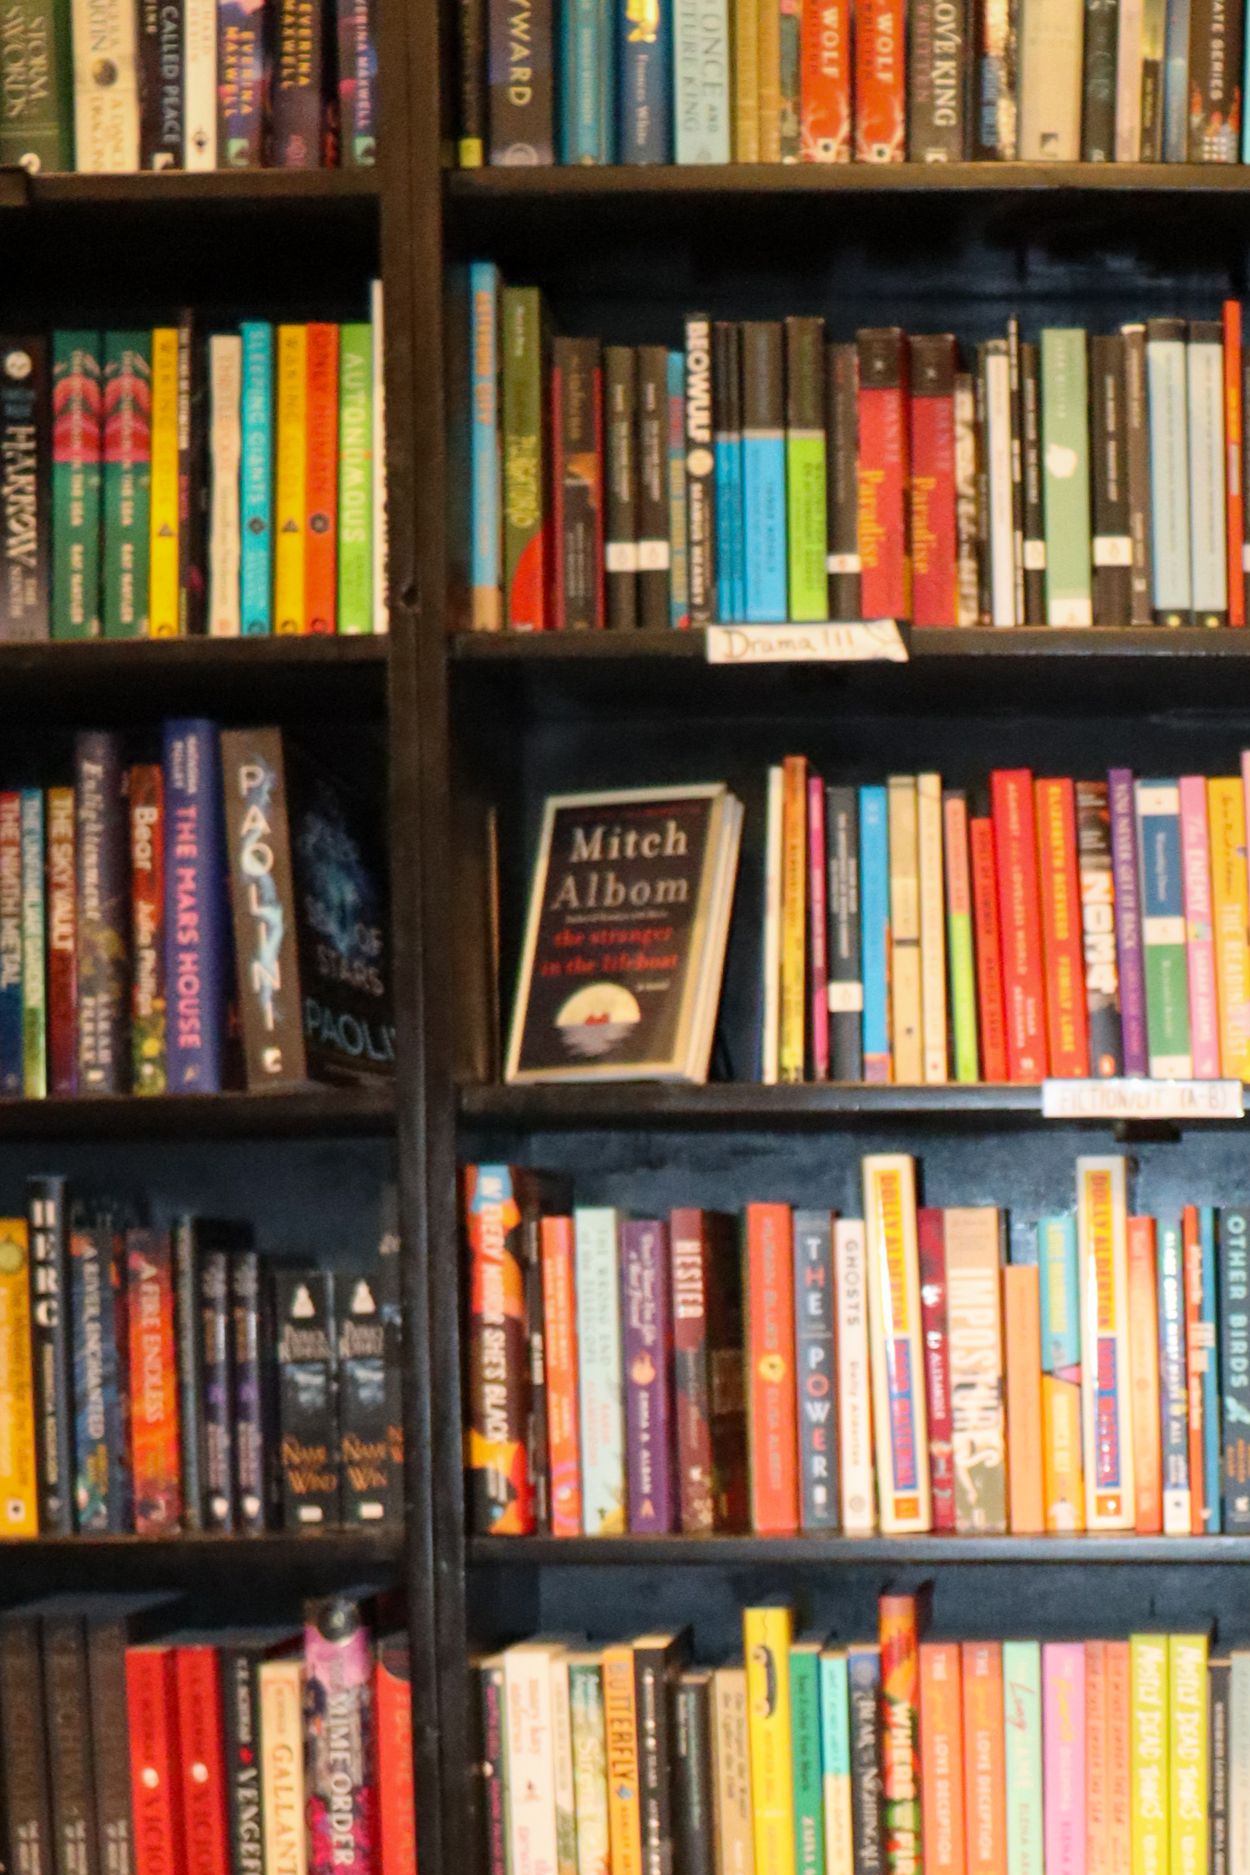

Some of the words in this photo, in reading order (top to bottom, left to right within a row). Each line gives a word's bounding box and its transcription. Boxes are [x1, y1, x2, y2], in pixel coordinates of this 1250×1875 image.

[161, 6, 179, 80] CALLED
[699, 14, 724, 97] ONCE
[820, 7, 840, 79] WOLF
[875, 12, 895, 85] WOLF
[163, 85, 180, 142] PEACE
[930, 65, 957, 127] KING
[687, 321, 711, 443] BEOWULF
[342, 353, 366, 543] AUTONOMOUS
[858, 469, 885, 567] Paradise
[912, 477, 937, 575] Paradise
[134, 805, 158, 870] Bear
[176, 805, 197, 859] THE
[569, 820, 687, 863] Mitch
[177, 868, 199, 946] MARS
[237, 764, 283, 1031] PAOLINI
[552, 871, 687, 909] Albom
[1187, 849, 1207, 912] ENEMY
[1223, 904, 1241, 937] THE
[178, 952, 202, 1049] HOUSE
[1225, 940, 1245, 1016] READING
[676, 1239, 703, 1319] HESTER
[804, 1238, 826, 1316] THE
[846, 1238, 867, 1327] GHOSTS
[1227, 1214, 1248, 1300] OTHER
[142, 1283, 160, 1328] FIRE
[143, 1334, 164, 1423] ENDLESS
[1229, 1314, 1248, 1388] BIRDS
[805, 1347, 831, 1478] POWER
[329, 1693, 351, 1762] MIME
[608, 1661, 636, 1782] BUTTERFLY
[330, 1772, 355, 1865] ORDER
